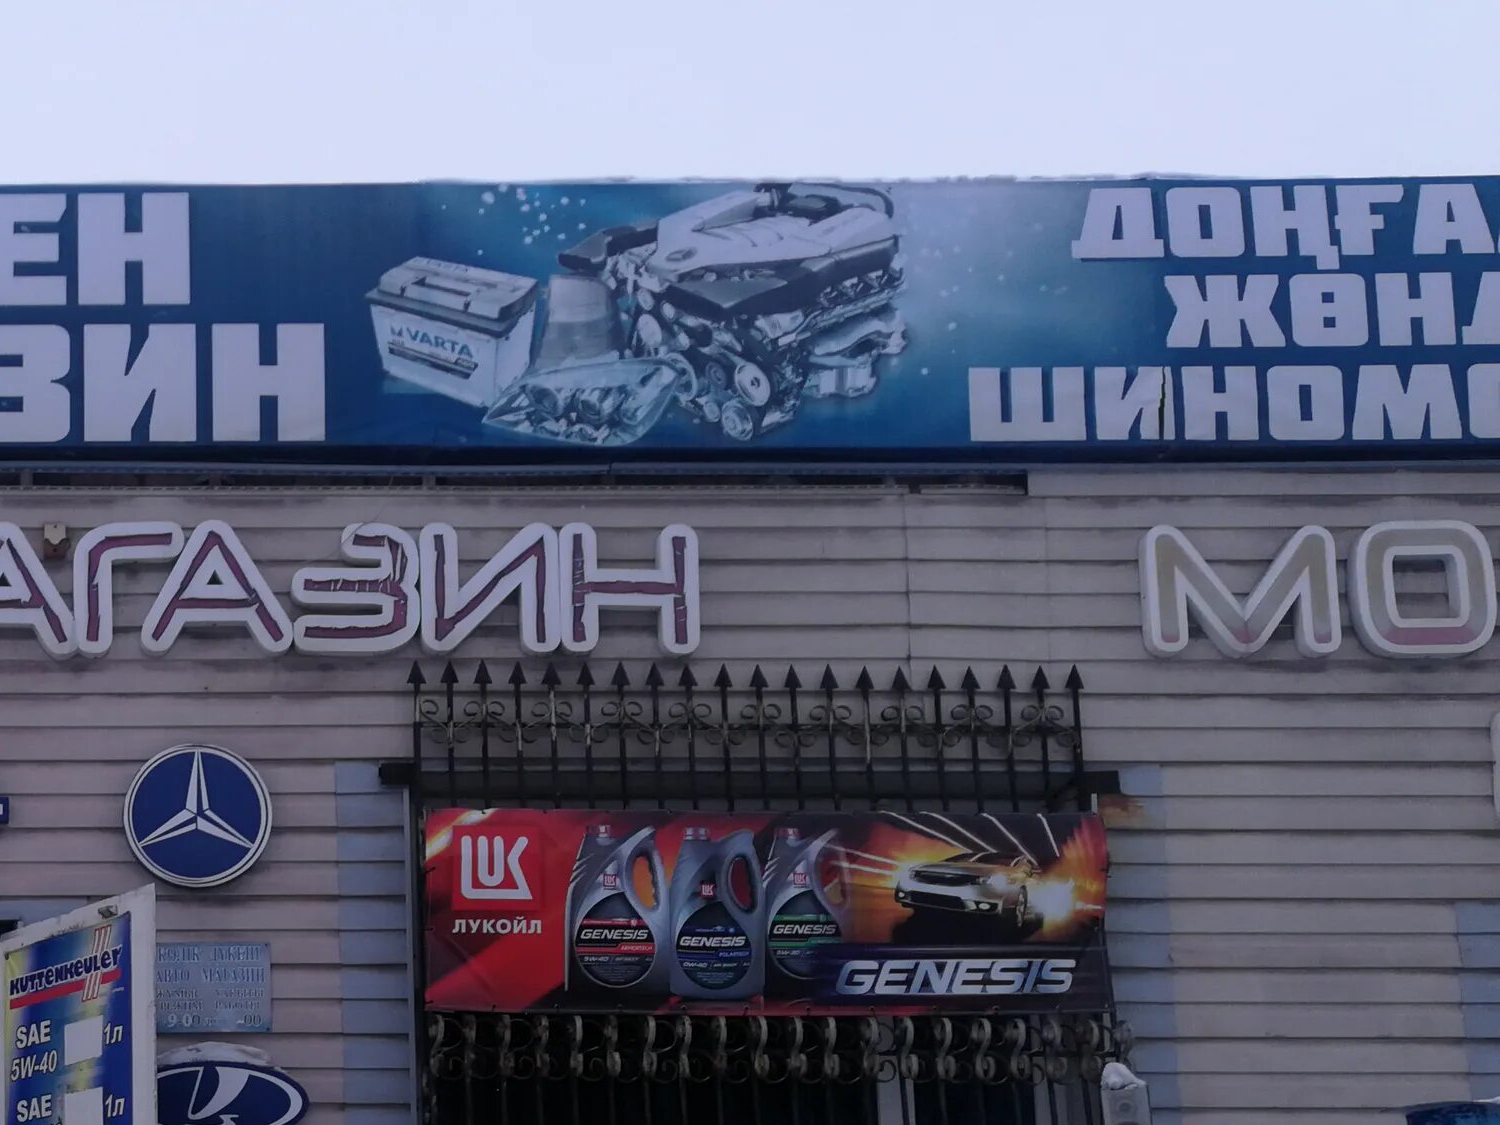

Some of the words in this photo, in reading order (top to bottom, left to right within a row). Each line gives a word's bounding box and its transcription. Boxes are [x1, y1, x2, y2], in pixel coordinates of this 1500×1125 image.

[1072, 184, 1500, 270] ДОҢҒА
[406, 327, 474, 359] VARTA
[452, 916, 542, 934] ЛУКОЙЛ
[580, 929, 649, 940] GENESIS
[773, 924, 837, 935] GENESIS
[679, 936, 747, 947] GENESIS
[835, 958, 1077, 995] GENESIS
[15, 1020, 51, 1049] SAE
[104, 1022, 123, 1045] 1л
[11, 1050, 57, 1082] 5W-40
[16, 1094, 52, 1122] SAE
[105, 1094, 125, 1118] 1л
